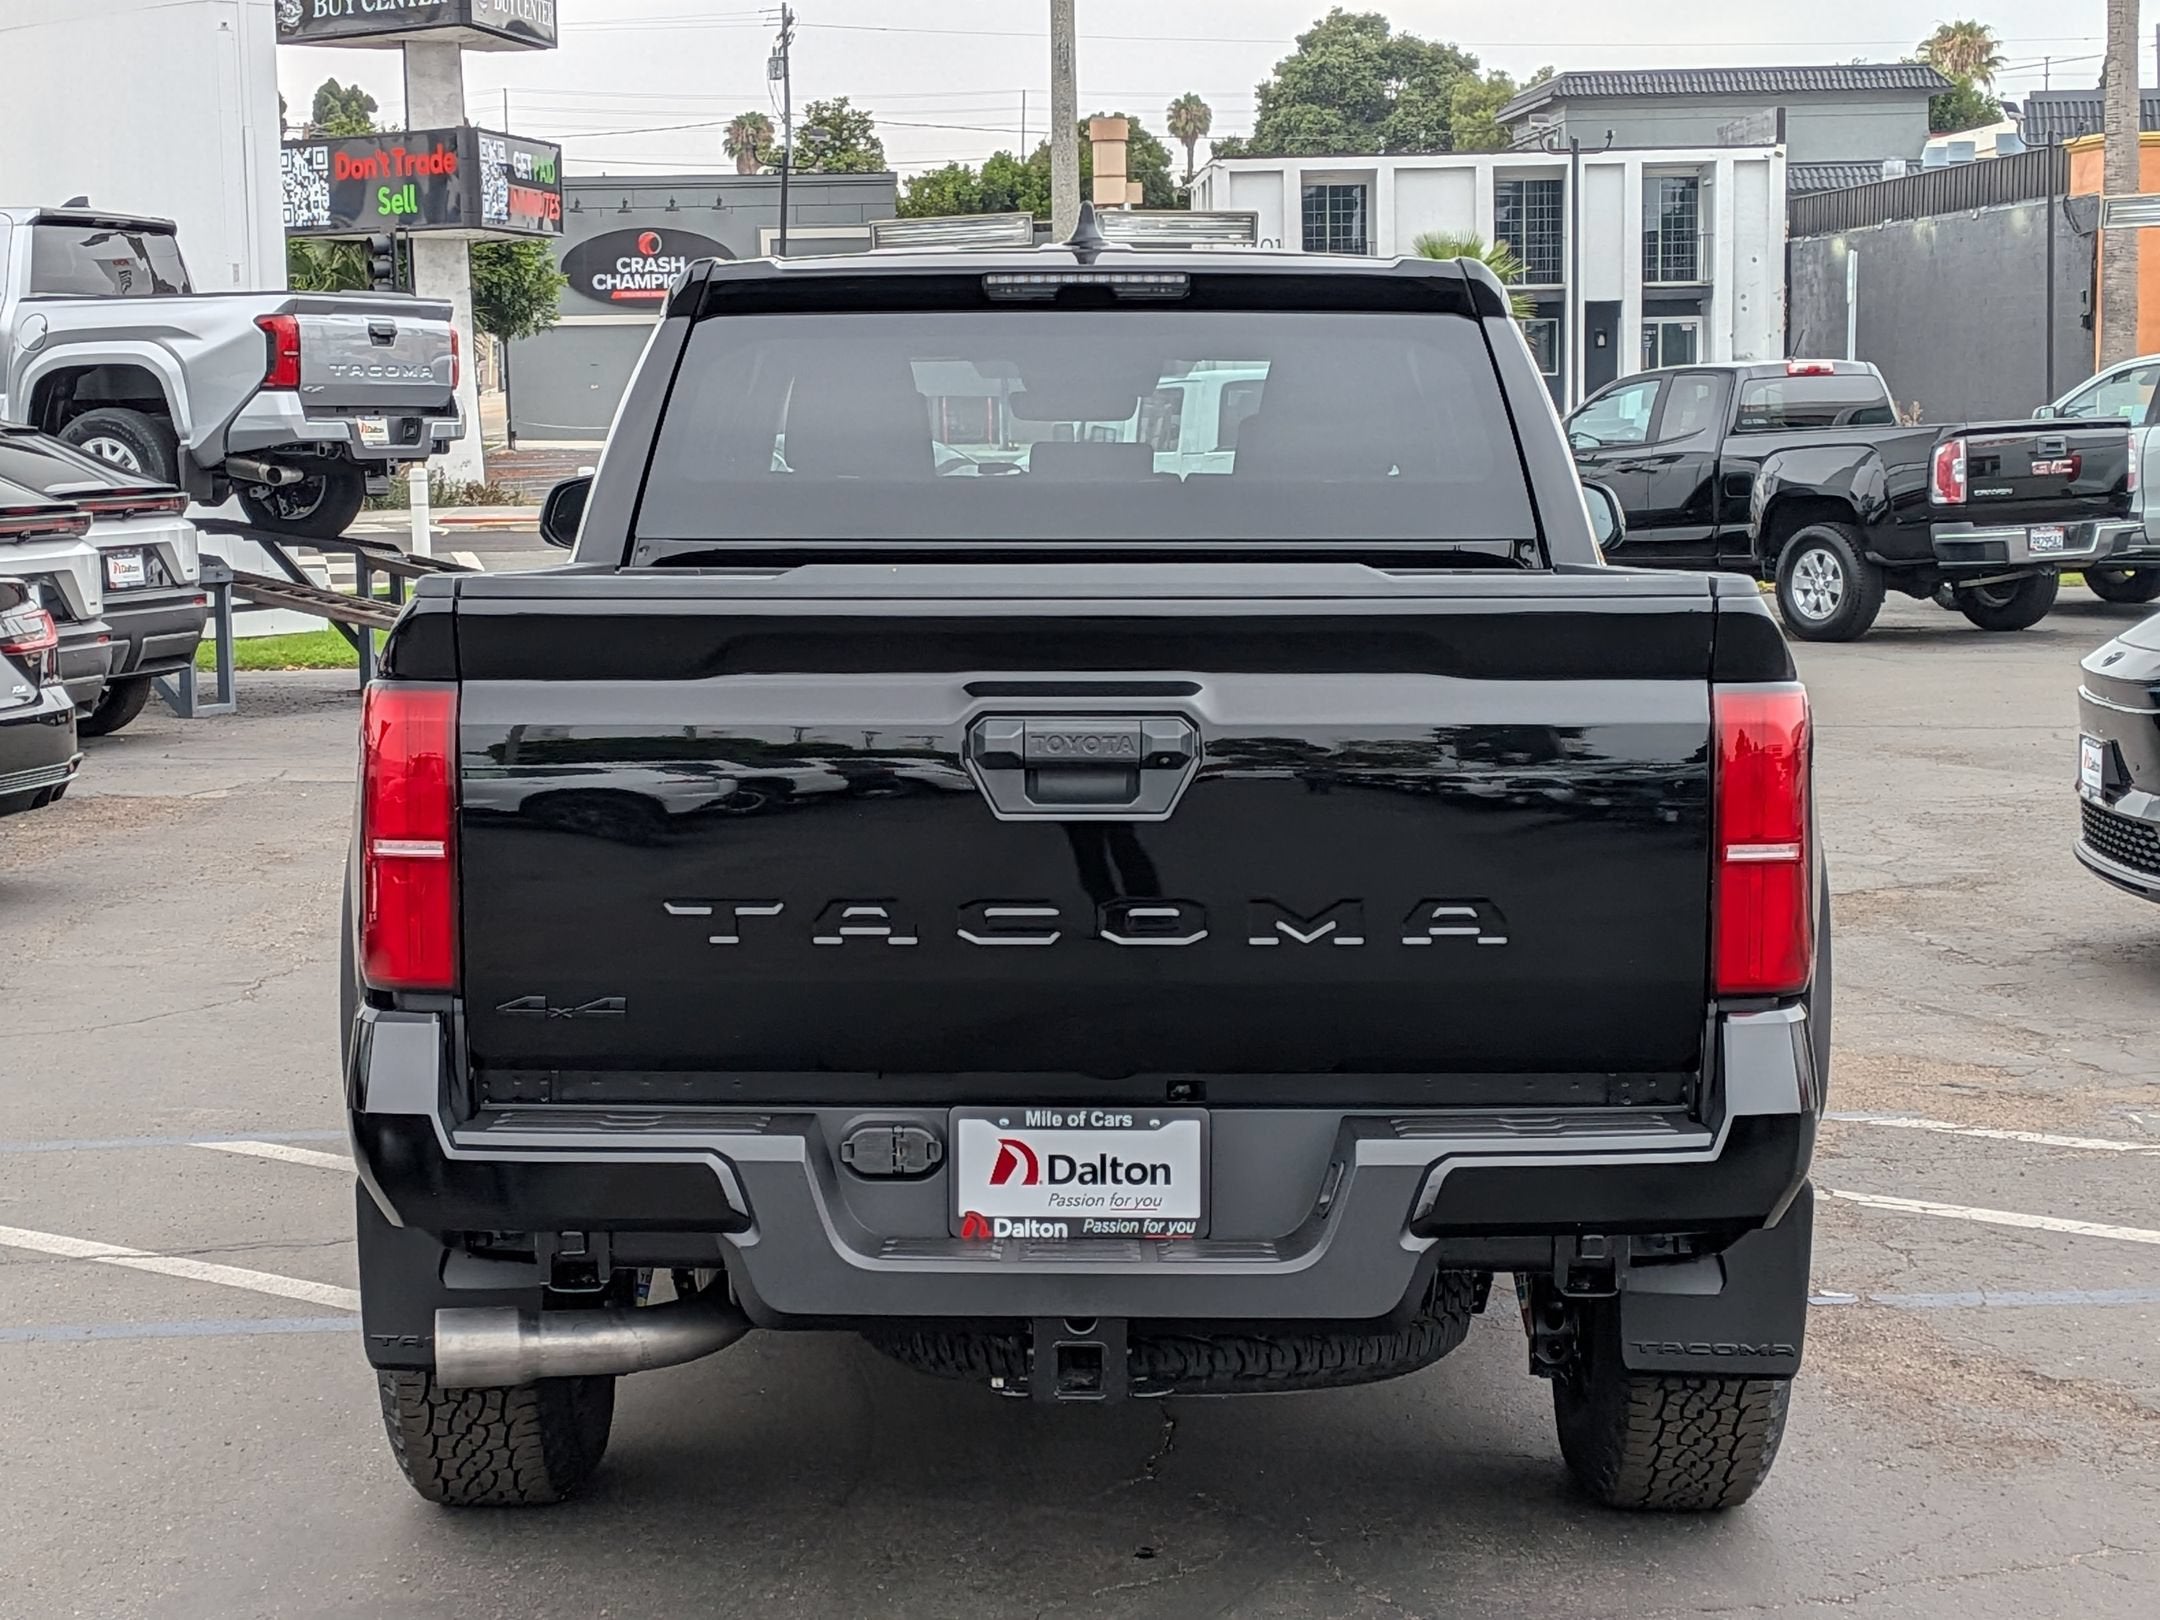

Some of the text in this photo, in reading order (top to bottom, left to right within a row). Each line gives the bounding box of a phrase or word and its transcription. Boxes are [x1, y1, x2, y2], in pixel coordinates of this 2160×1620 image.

[361, 0, 448, 13] CEN
[334, 143, 457, 181] Don't Trade
[377, 184, 418, 216] Sell
[616, 256, 686, 273] CRASH
[328, 364, 434, 378] TACOMA
[2032, 459, 2073, 475] GMC
[1031, 735, 1136, 754] TOYOTA
[663, 897, 1509, 945] TACOMA
[1025, 1110, 1133, 1127] Mile of Cars
[1048, 1153, 1171, 1185] Dalton
[1048, 1193, 1162, 1208] Passion for you
[993, 1218, 1196, 1238] Dalton Passion for you
[1628, 1341, 1796, 1358] TACOMA
